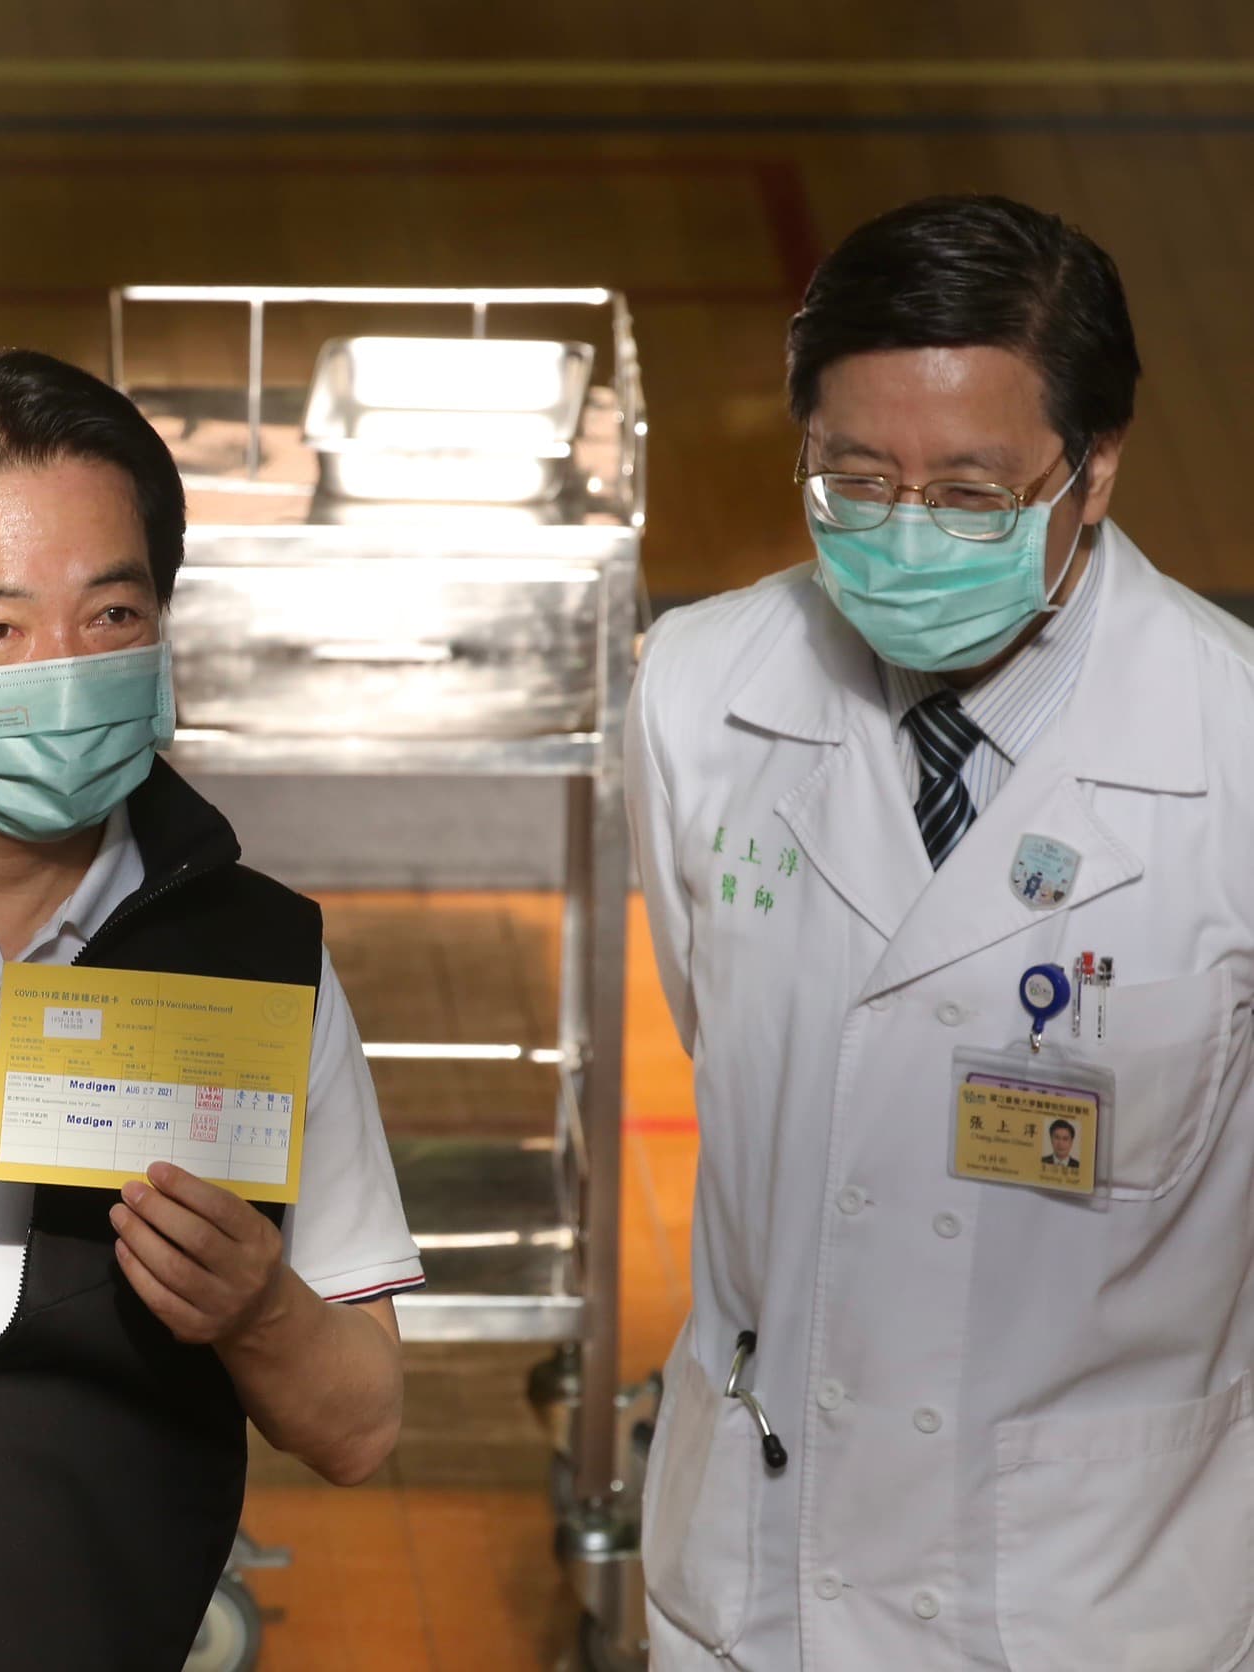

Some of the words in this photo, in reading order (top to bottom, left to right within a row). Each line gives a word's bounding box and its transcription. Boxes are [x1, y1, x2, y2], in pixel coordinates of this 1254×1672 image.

[69, 1079, 116, 1094] Medigen
[125, 1086, 141, 1096] AUG
[157, 1088, 173, 1097] 2021
[66, 1113, 113, 1129] Medigen
[121, 1120, 137, 1129] SEP
[153, 1121, 170, 1131] 2021
